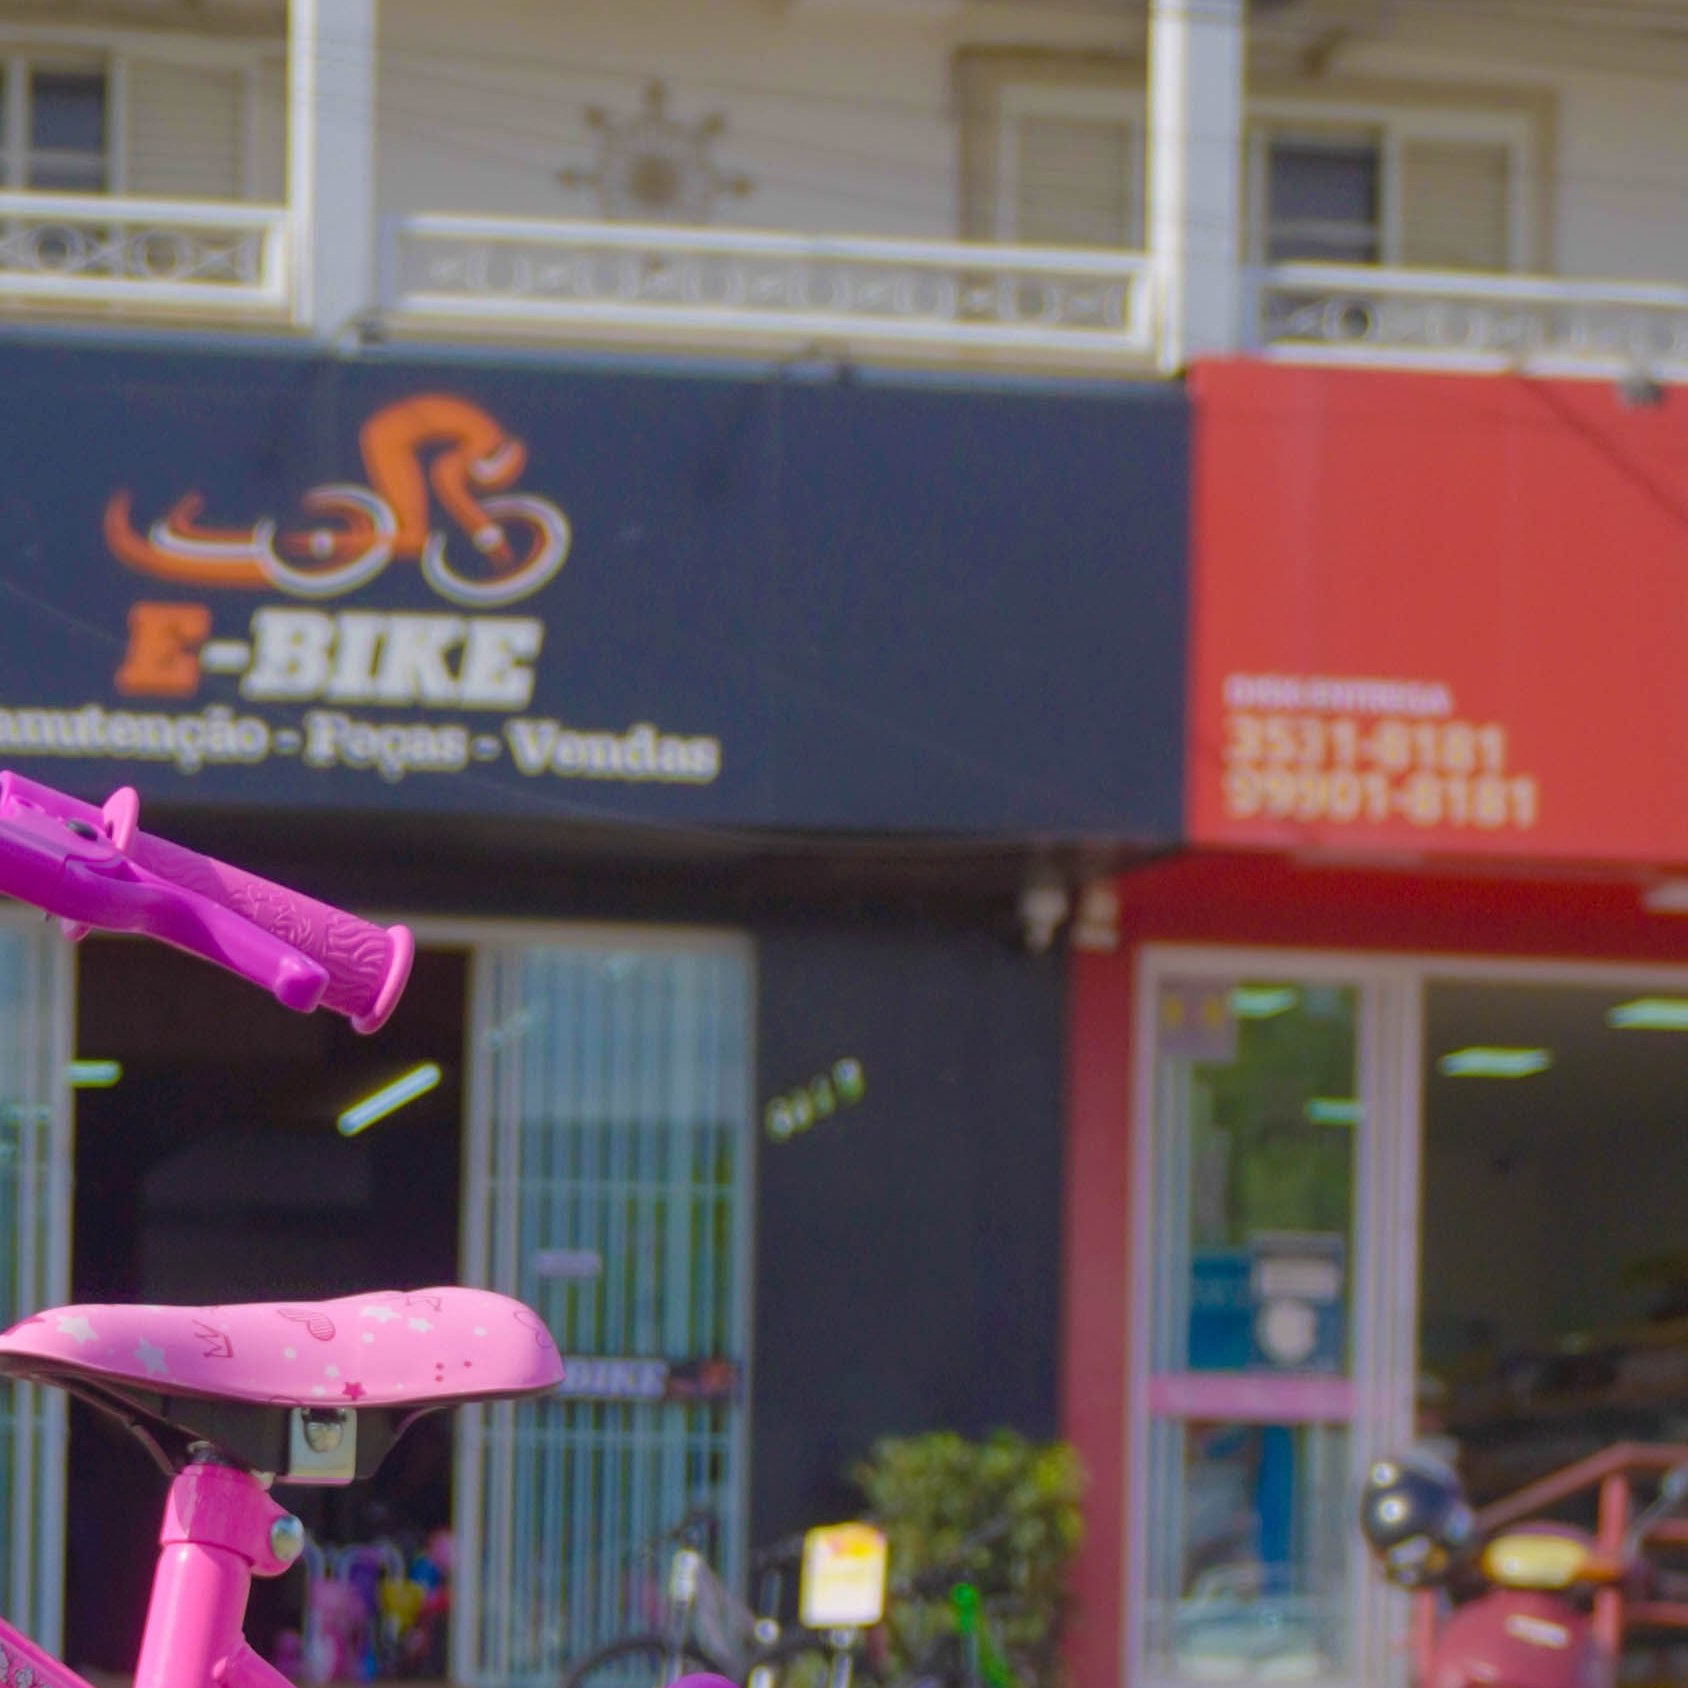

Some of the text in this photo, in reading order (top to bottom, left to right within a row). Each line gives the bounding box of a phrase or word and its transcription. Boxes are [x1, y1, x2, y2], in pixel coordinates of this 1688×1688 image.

[116, 603, 543, 708] E-BIKE
[311, 714, 466, 777] Peças
[509, 724, 719, 779] Vendas
